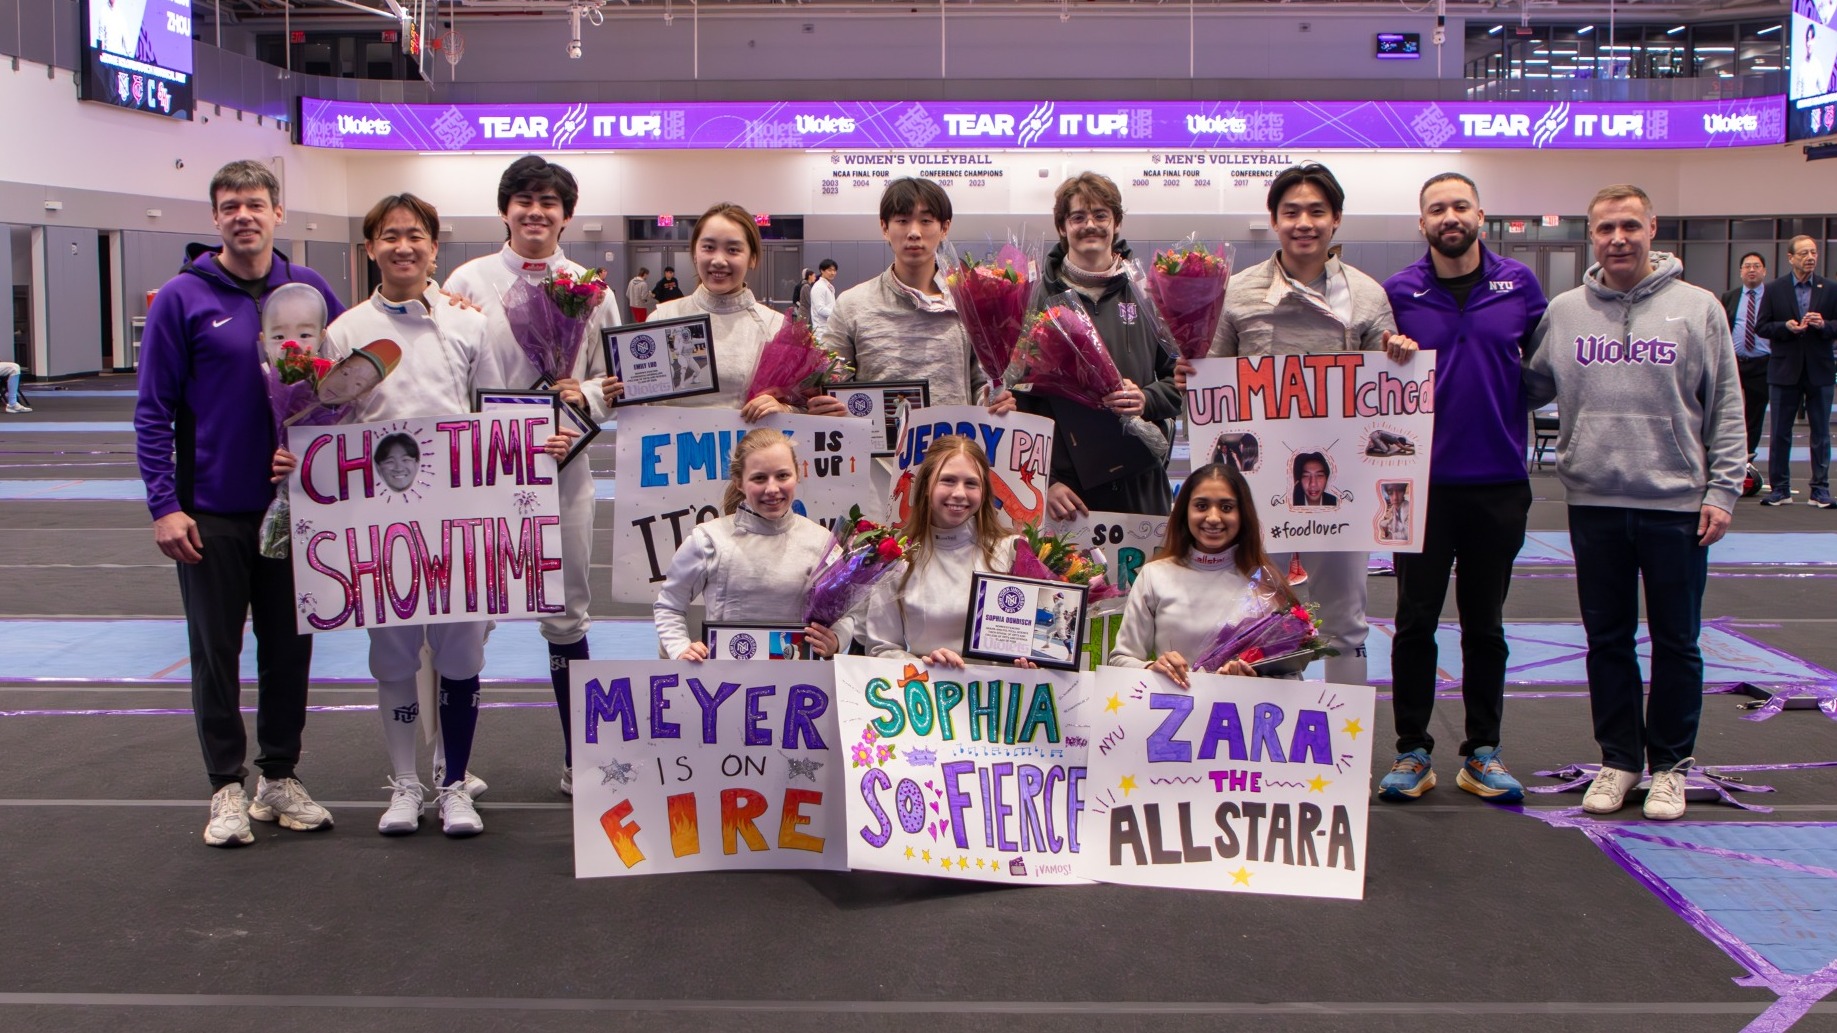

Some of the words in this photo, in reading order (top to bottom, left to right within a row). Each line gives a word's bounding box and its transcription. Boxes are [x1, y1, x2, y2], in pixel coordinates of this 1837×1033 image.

[167, 11, 191, 37] ZHOU
[337, 114, 391, 135] Violets
[479, 116, 549, 138] TEAR
[593, 116, 616, 136] IT
[620, 116, 661, 136] UP!
[795, 114, 855, 134] Violets
[943, 114, 1015, 135] TEAR
[1060, 114, 1083, 135] IT
[1086, 114, 1128, 135] UP!
[1186, 114, 1246, 134] Violets
[1459, 114, 1530, 136] TEAR
[1575, 115, 1598, 136] IT
[1601, 115, 1643, 136] UP!
[1703, 113, 1757, 134] Violets
[844, 155, 905, 164] WOMEN'S
[909, 154, 992, 164] VOLLEYBALL
[1165, 155, 1206, 164] MEN'S
[1210, 154, 1292, 164] VOLLEYBALL
[1489, 281, 1513, 290] NYU
[1574, 331, 1678, 367] Violets
[1187, 354, 1435, 425] unMATTched
[436, 417, 553, 488] TIME
[814, 430, 844, 452] IS
[1010, 429, 1052, 477] PA
[814, 455, 844, 478] UP
[1092, 523, 1124, 546] SO
[1271, 520, 1350, 539] #foodlover
[306, 515, 565, 630] SHOWTIME
[585, 674, 829, 750] MEYER
[865, 677, 1061, 745] SOPHIA
[1099, 725, 1125, 755] NYU
[1146, 692, 1334, 765] ZARA
[657, 755, 693, 785] IS
[721, 753, 766, 777] ON
[1208, 769, 1262, 793] THE
[860, 767, 926, 848] SO
[941, 761, 1087, 854] FIERCE
[600, 787, 826, 869] FIRE
[1035, 863, 1072, 877] ¡VAMOS!
